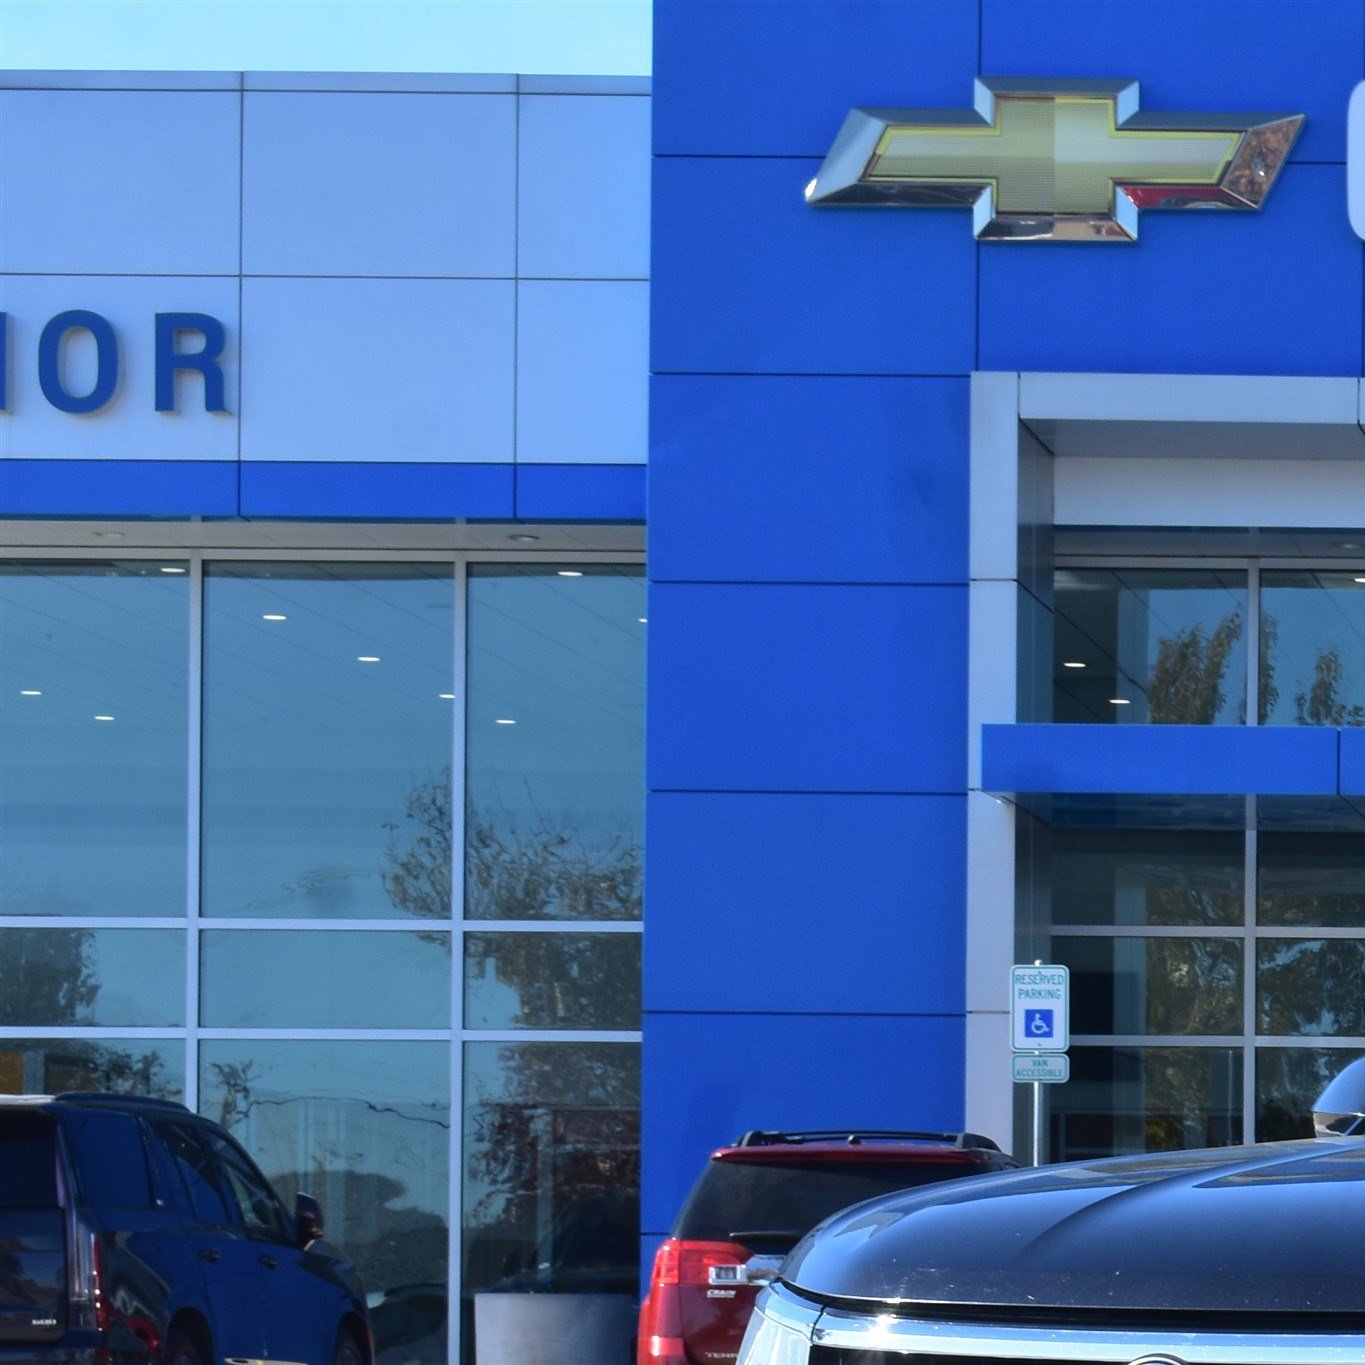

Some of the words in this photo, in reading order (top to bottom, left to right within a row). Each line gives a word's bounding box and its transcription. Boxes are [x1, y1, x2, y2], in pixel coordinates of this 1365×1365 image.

[1015, 973, 1064, 985] RESERVED
[1018, 988, 1061, 1000] PARKING
[1031, 1059, 1049, 1067] VAN
[1016, 1068, 1063, 1078] ACCESSIBLE
